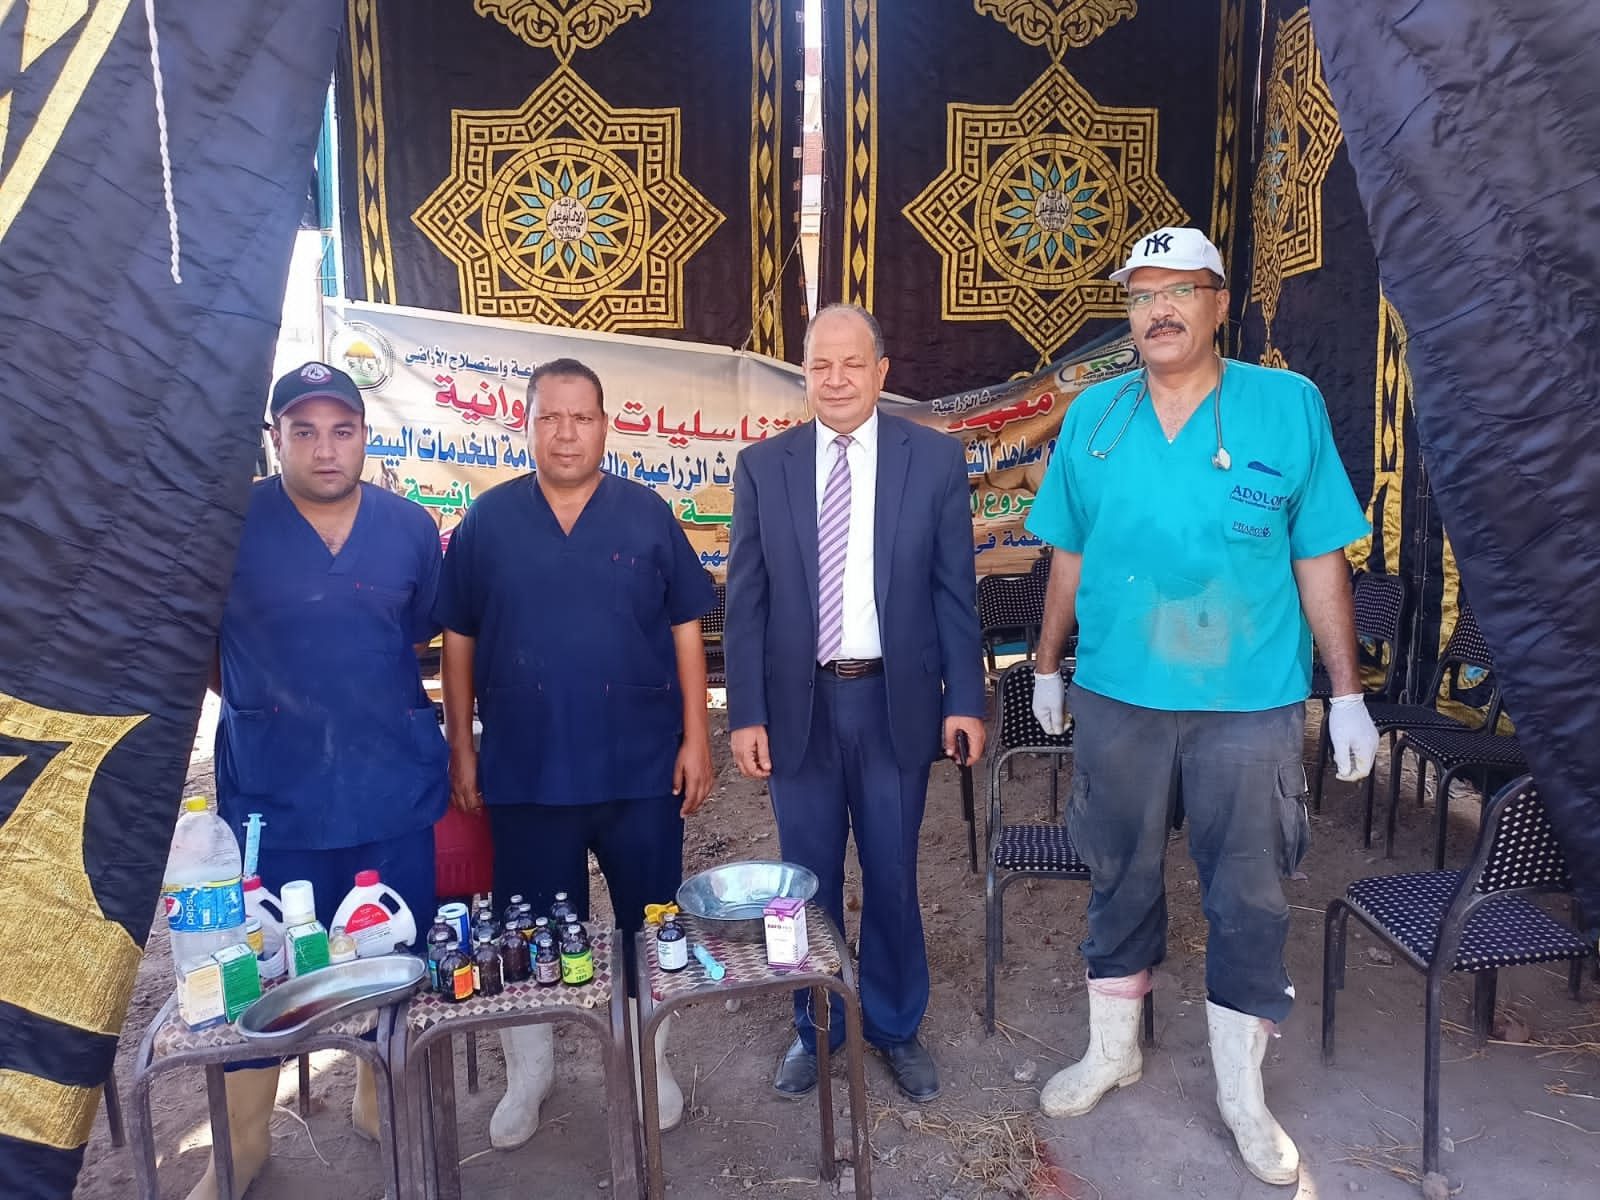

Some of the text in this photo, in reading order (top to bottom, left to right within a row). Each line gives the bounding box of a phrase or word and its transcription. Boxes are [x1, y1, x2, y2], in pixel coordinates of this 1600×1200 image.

[449, 354, 508, 377] واستصلاح
[435, 374, 529, 429] وانية
[614, 401, 803, 446] تناسليات
[366, 424, 412, 466] البيط
[418, 428, 496, 467] للخدمات
[501, 434, 536, 469] امة
[633, 451, 707, 490] الزراعية
[405, 478, 474, 513] انية
[984, 493, 1036, 518] روع
